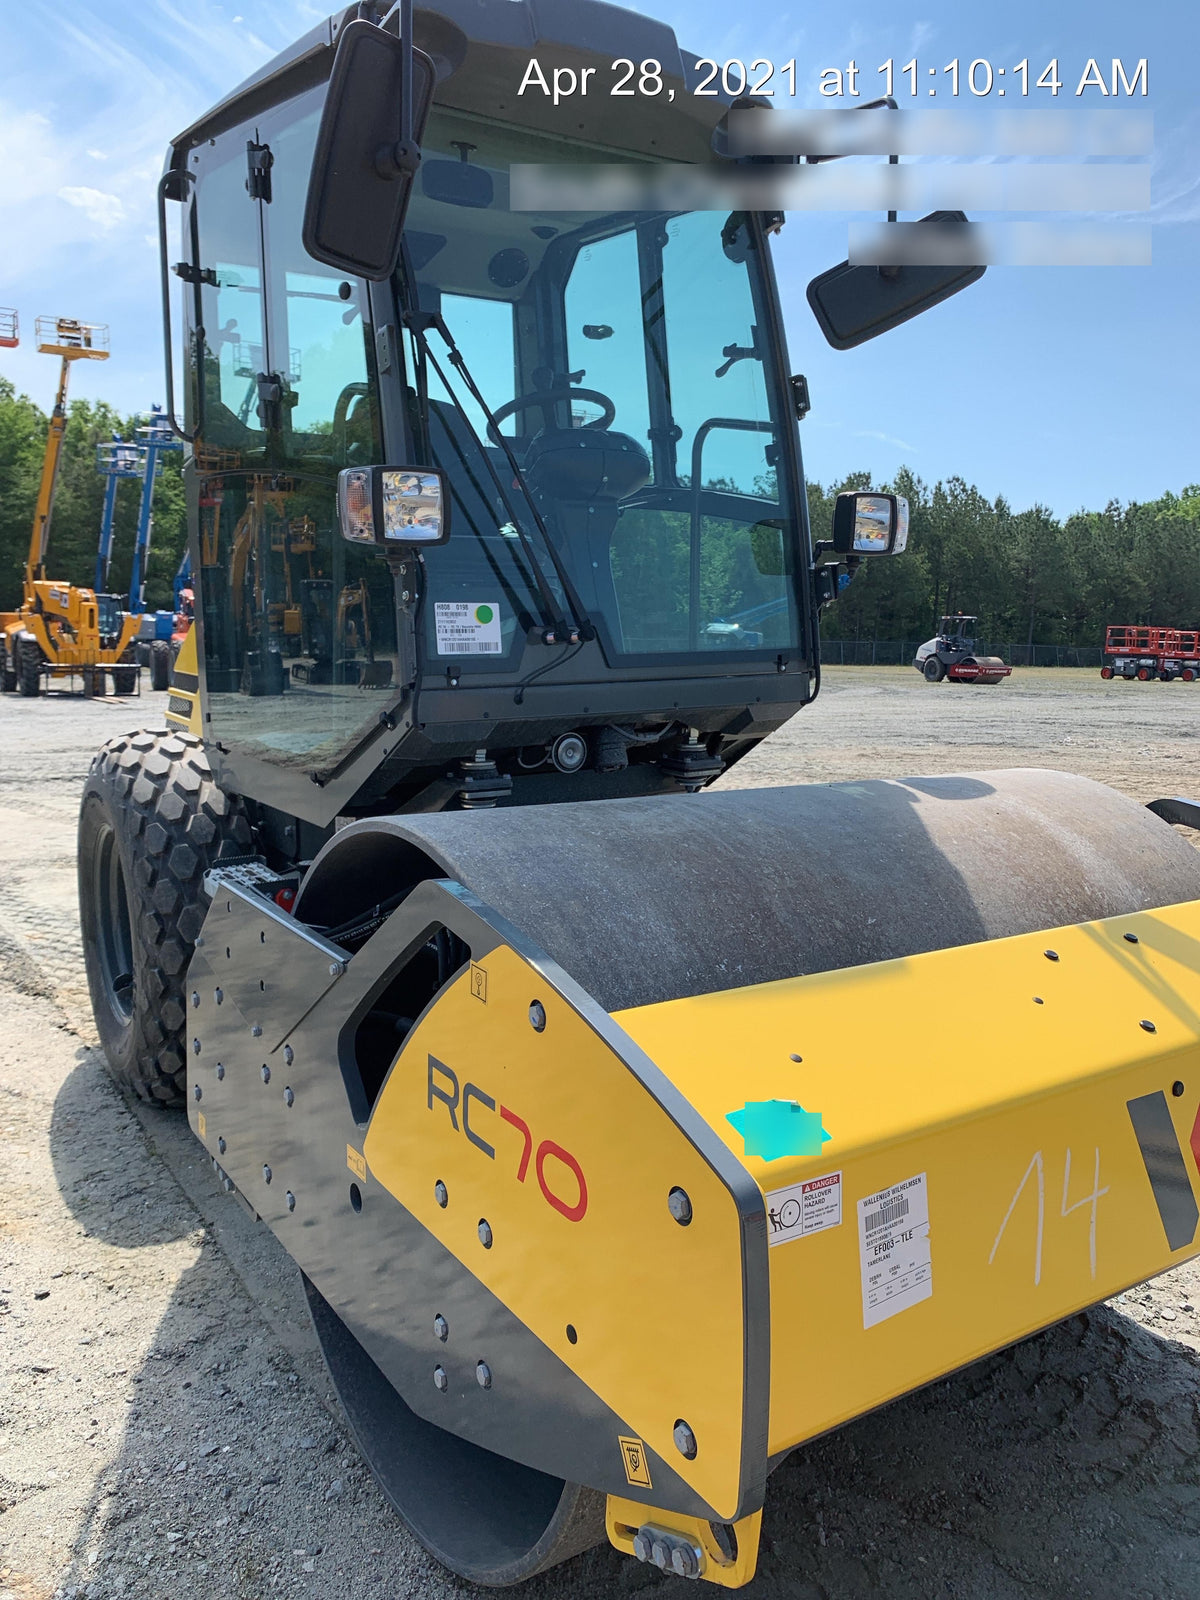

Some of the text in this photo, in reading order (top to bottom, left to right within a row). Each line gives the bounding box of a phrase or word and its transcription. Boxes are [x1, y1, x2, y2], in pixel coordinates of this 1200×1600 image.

[428, 1053, 588, 1222] RC70
[811, 1176, 838, 1190] DANGER
[804, 1188, 832, 1201] ROLLOVER
[863, 1177, 922, 1207] WALLENIUS WILHELMSEN
[804, 1198, 826, 1208] HAZARD
[880, 1193, 904, 1210] LOGISTICS
[988, 1147, 1110, 1286] 14
[867, 1252, 891, 1268] TAMERLANE
